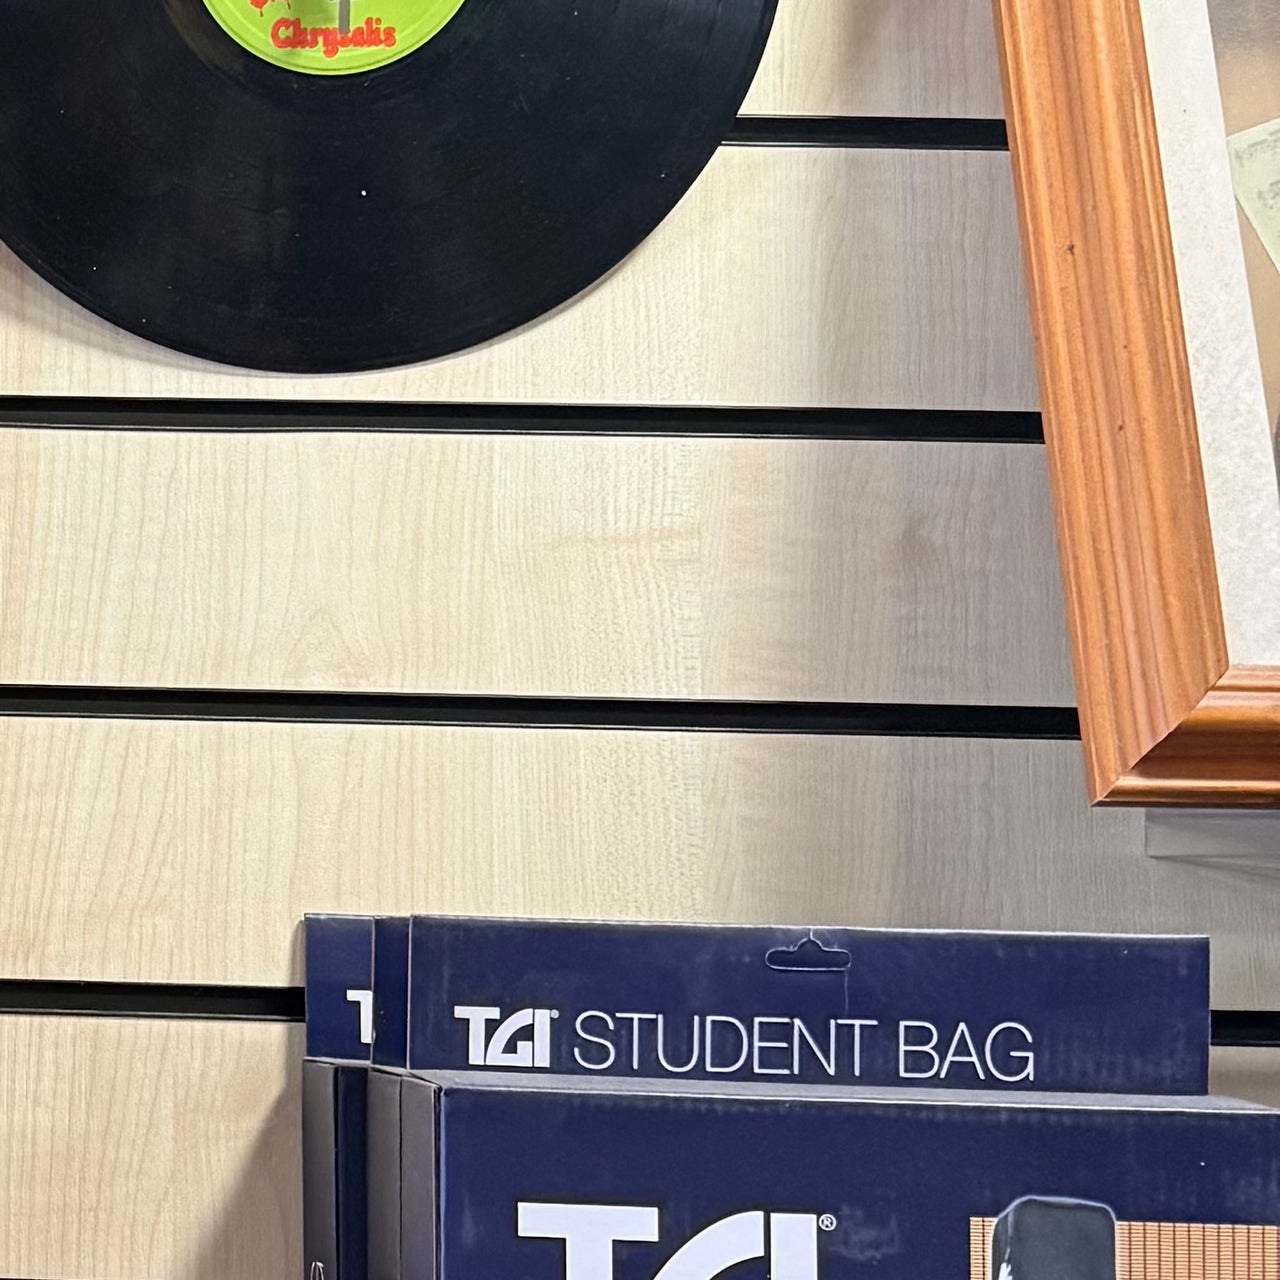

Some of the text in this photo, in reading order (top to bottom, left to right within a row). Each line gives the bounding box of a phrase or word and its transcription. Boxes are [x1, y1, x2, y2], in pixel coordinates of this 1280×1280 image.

[271, 17, 396, 58] Chrysalis
[454, 1006, 1035, 1082] TGI STUDENT BAG
